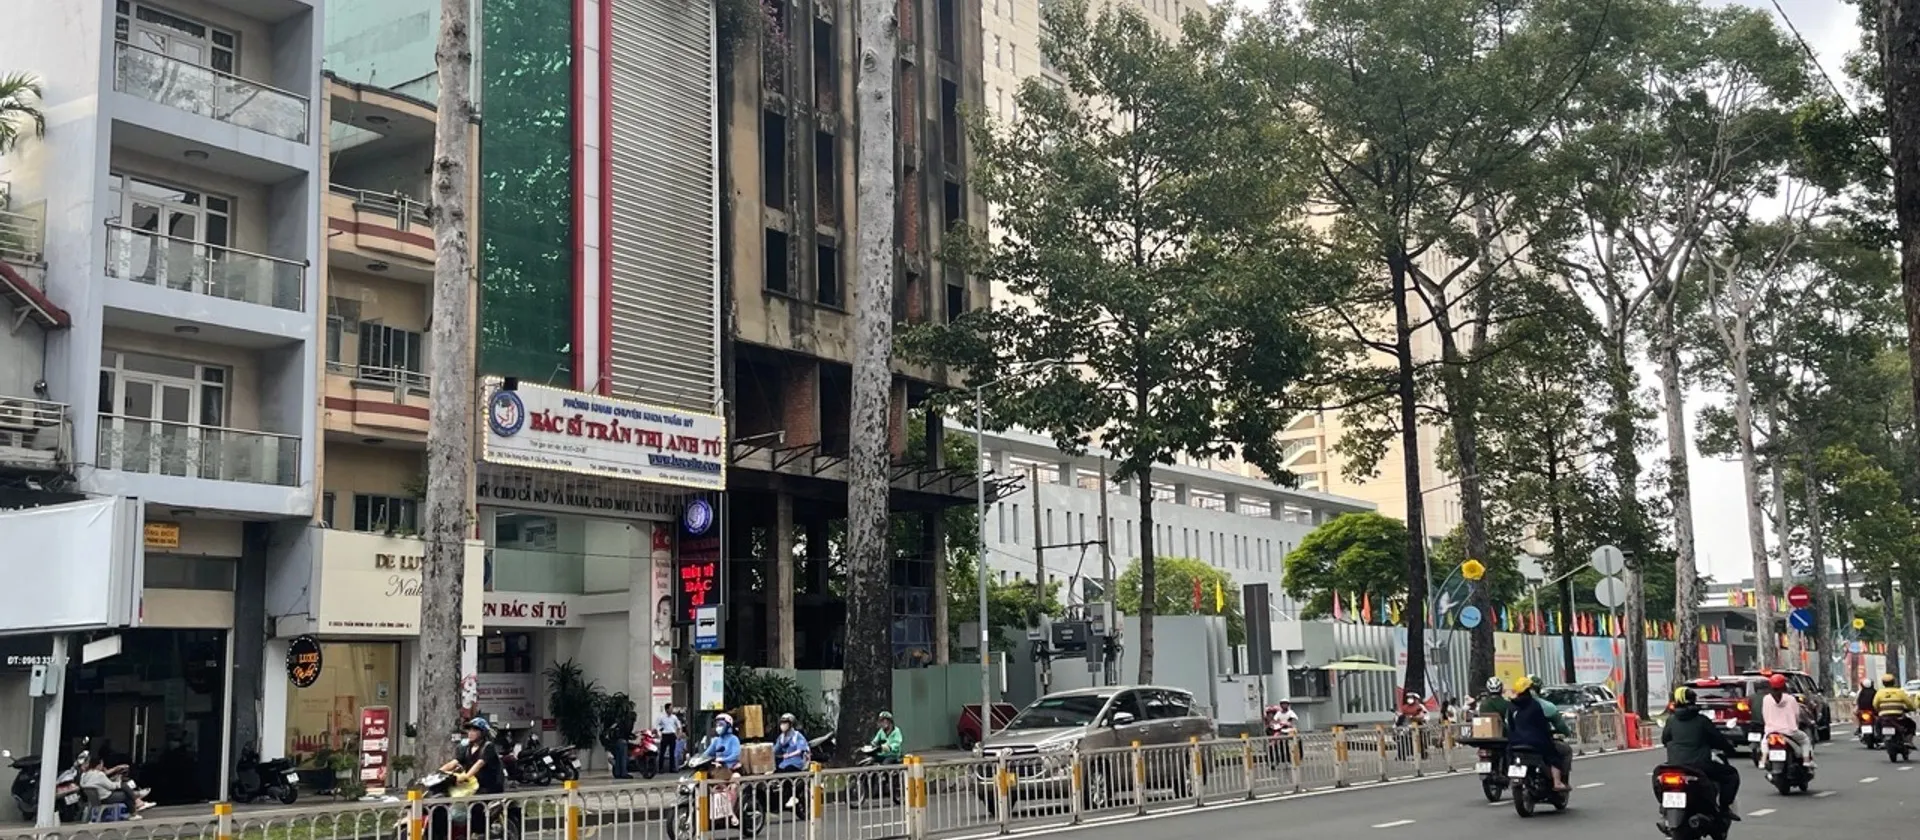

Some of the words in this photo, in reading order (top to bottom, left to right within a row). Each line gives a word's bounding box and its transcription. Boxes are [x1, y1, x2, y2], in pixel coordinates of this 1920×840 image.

[529, 410, 563, 433] BÁC
[567, 414, 583, 437] SĨ
[586, 419, 631, 444] TRẦN
[634, 428, 663, 453] THỊ
[666, 433, 699, 454] ANH
[701, 434, 721, 457] TÚ
[375, 553, 396, 569] DE
[500, 600, 528, 617] BÁC
[531, 601, 545, 618] SĨ
[548, 601, 567, 619] TÚ
